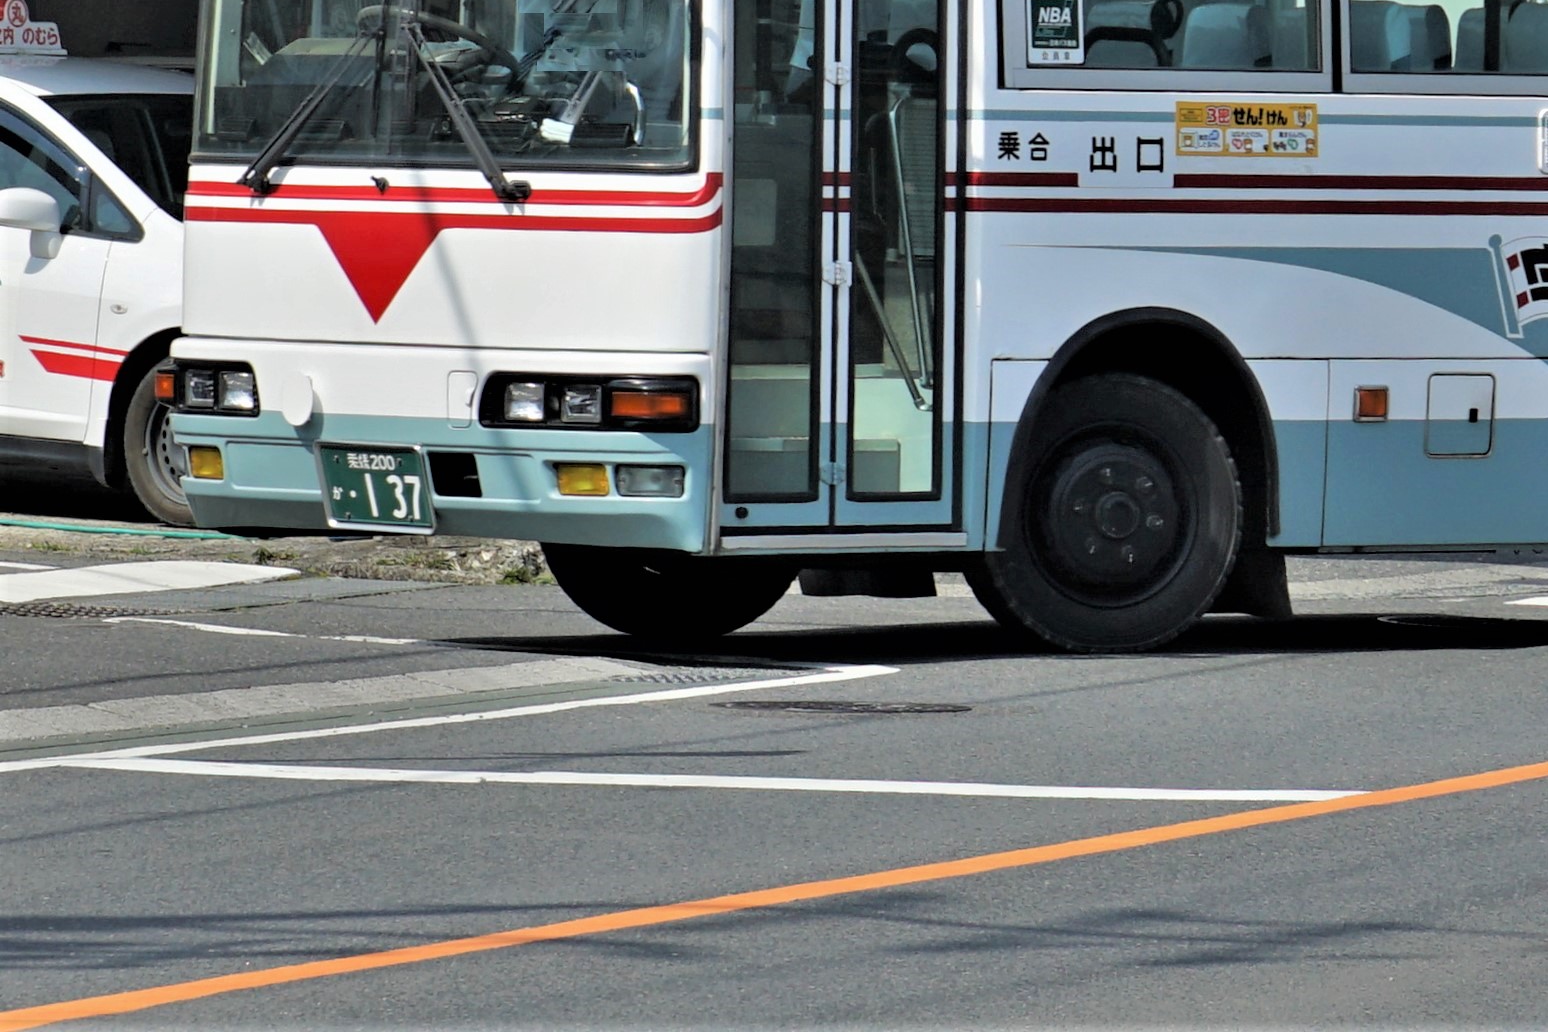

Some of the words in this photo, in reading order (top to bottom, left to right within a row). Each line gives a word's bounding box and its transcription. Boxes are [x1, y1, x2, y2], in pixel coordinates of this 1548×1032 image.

[1038, 7, 1072, 23] NBA
[22, 28, 58, 46] のむら
[998, 131, 1050, 161] 乗合
[1089, 136, 1165, 173] 出口
